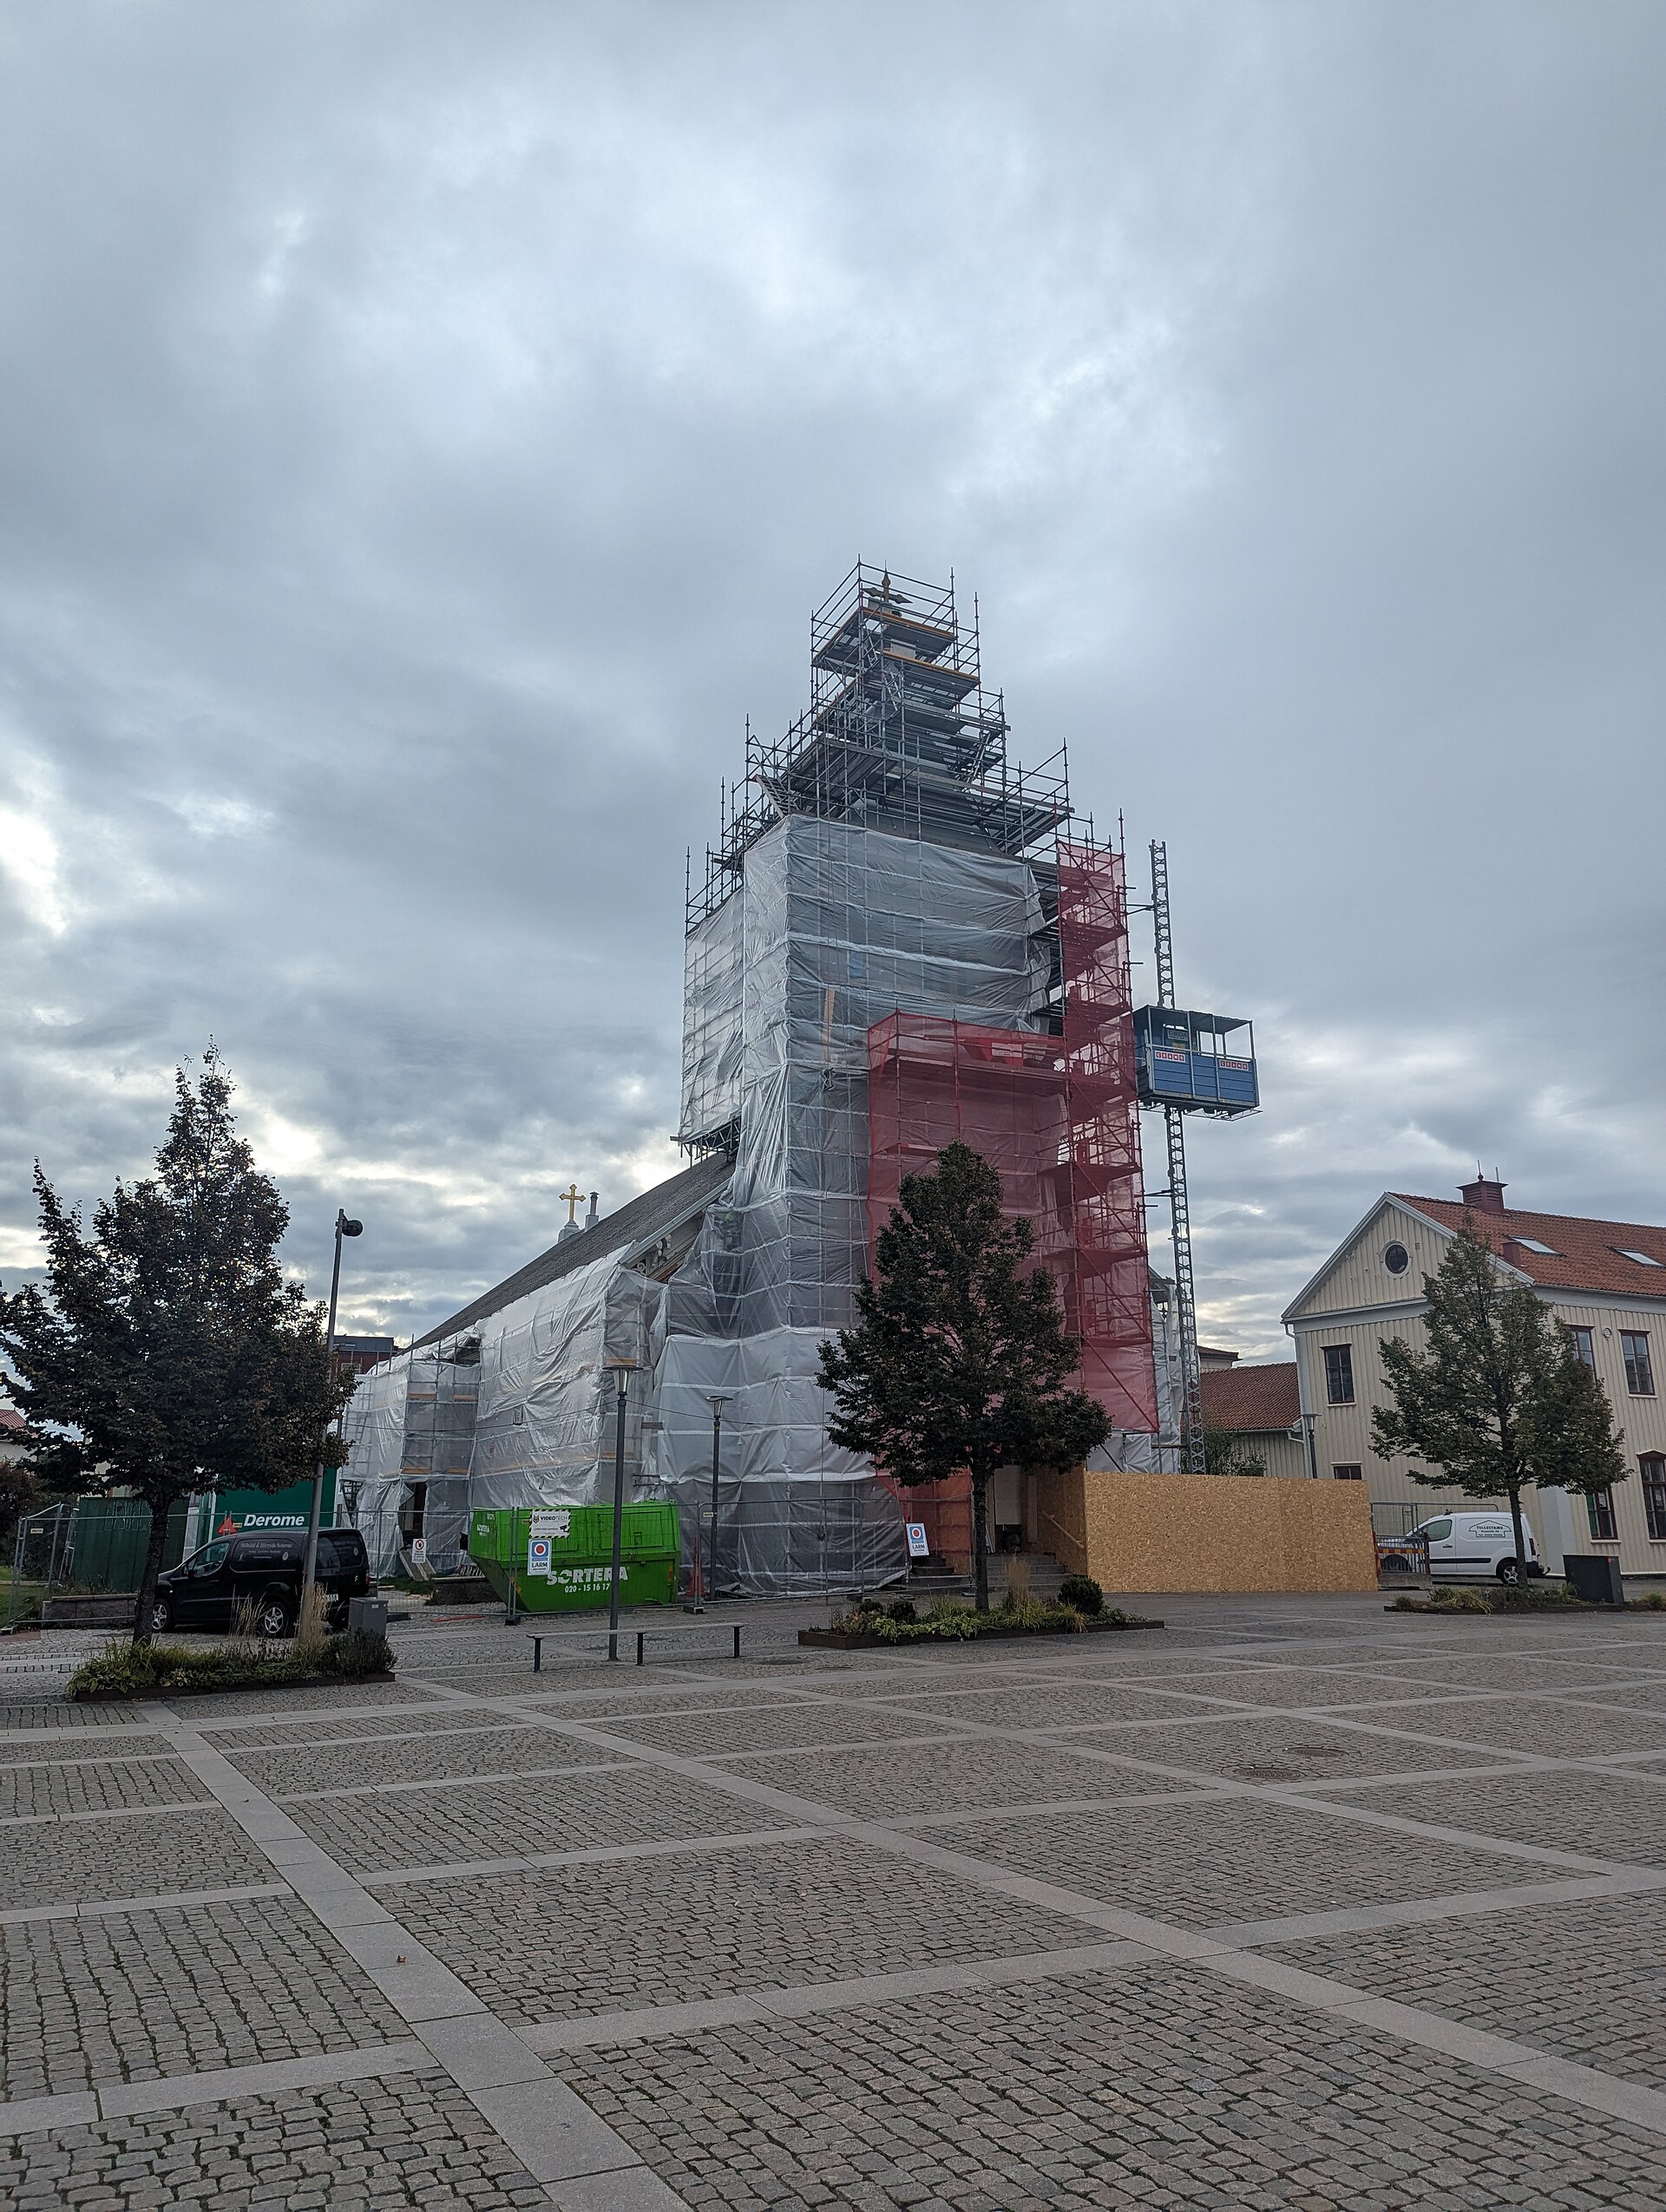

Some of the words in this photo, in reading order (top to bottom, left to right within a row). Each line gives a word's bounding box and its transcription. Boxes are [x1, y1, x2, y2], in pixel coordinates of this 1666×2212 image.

[1156, 1051, 1184, 1062] CRAMO
[1220, 1060, 1248, 1070] CRAMO
[244, 1514, 305, 1527] Derome
[547, 1567, 628, 1586] SORTERA
[565, 1585, 577, 1594] 020
